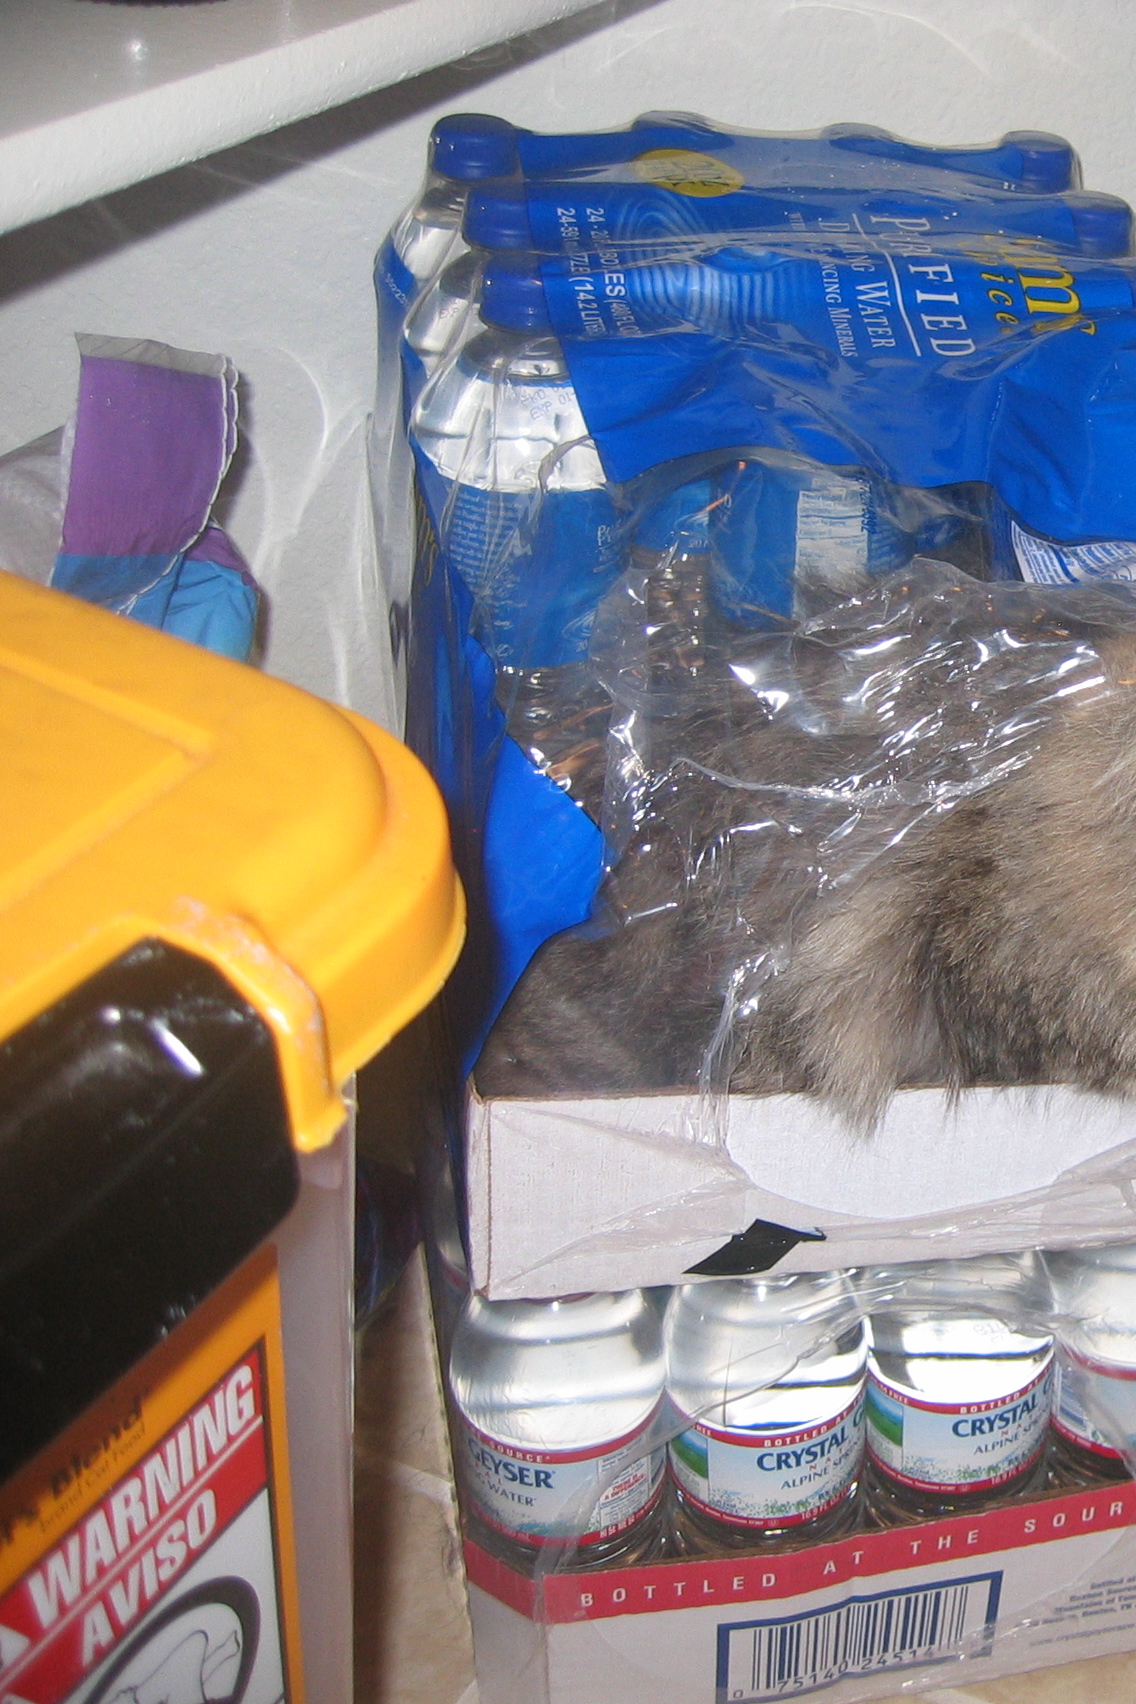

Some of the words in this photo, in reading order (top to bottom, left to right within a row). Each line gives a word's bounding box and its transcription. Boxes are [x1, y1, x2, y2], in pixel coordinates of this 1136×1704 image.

[585, 207, 606, 223] 24
[826, 306, 859, 358] MINERALS
[854, 280, 896, 349] WATER
[529, 401, 553, 421] EXP
[952, 1393, 1039, 1438] CRYSTAL
[959, 1390, 1021, 1415] BOTTLED
[490, 1440, 544, 1463] SOURCE
[756, 1425, 850, 1472] CRYSTAL
[764, 1426, 828, 1448] BOTTLED
[973, 1432, 1020, 1456] ALPINE
[468, 1437, 557, 1490] GEYSER
[781, 1466, 830, 1490] ALPINE
[26, 1364, 256, 1630] WARNING
[487, 1480, 535, 1507] WATER
[81, 1489, 217, 1668] AVISO
[580, 1572, 777, 1607] BOTTLED
[823, 1550, 864, 1575] AT
[909, 1529, 981, 1555] THE
[733, 1688, 744, 1700] 0
[777, 1657, 849, 1693] 75140
